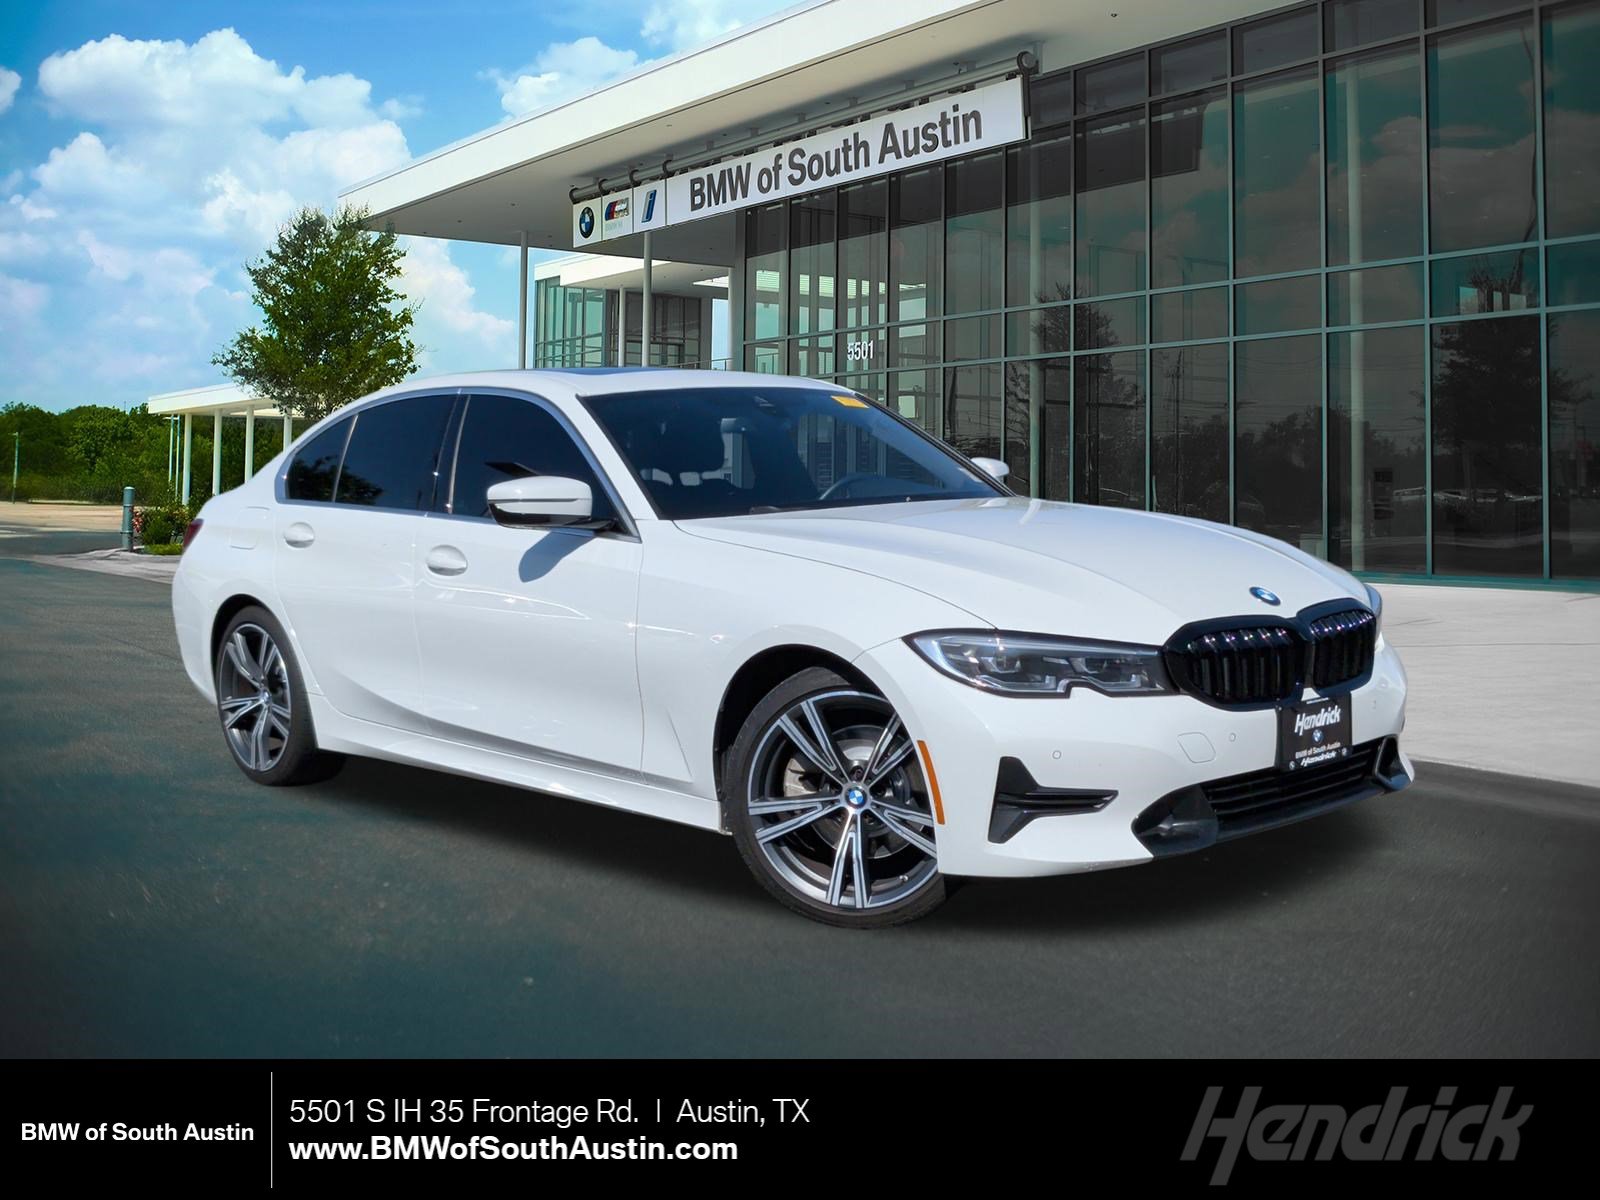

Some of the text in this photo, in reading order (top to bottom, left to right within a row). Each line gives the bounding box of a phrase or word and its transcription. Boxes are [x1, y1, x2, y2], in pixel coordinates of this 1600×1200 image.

[690, 103, 982, 212] BMW of South Austin
[847, 340, 873, 360] 5501
[1294, 705, 1341, 736] Hendrick
